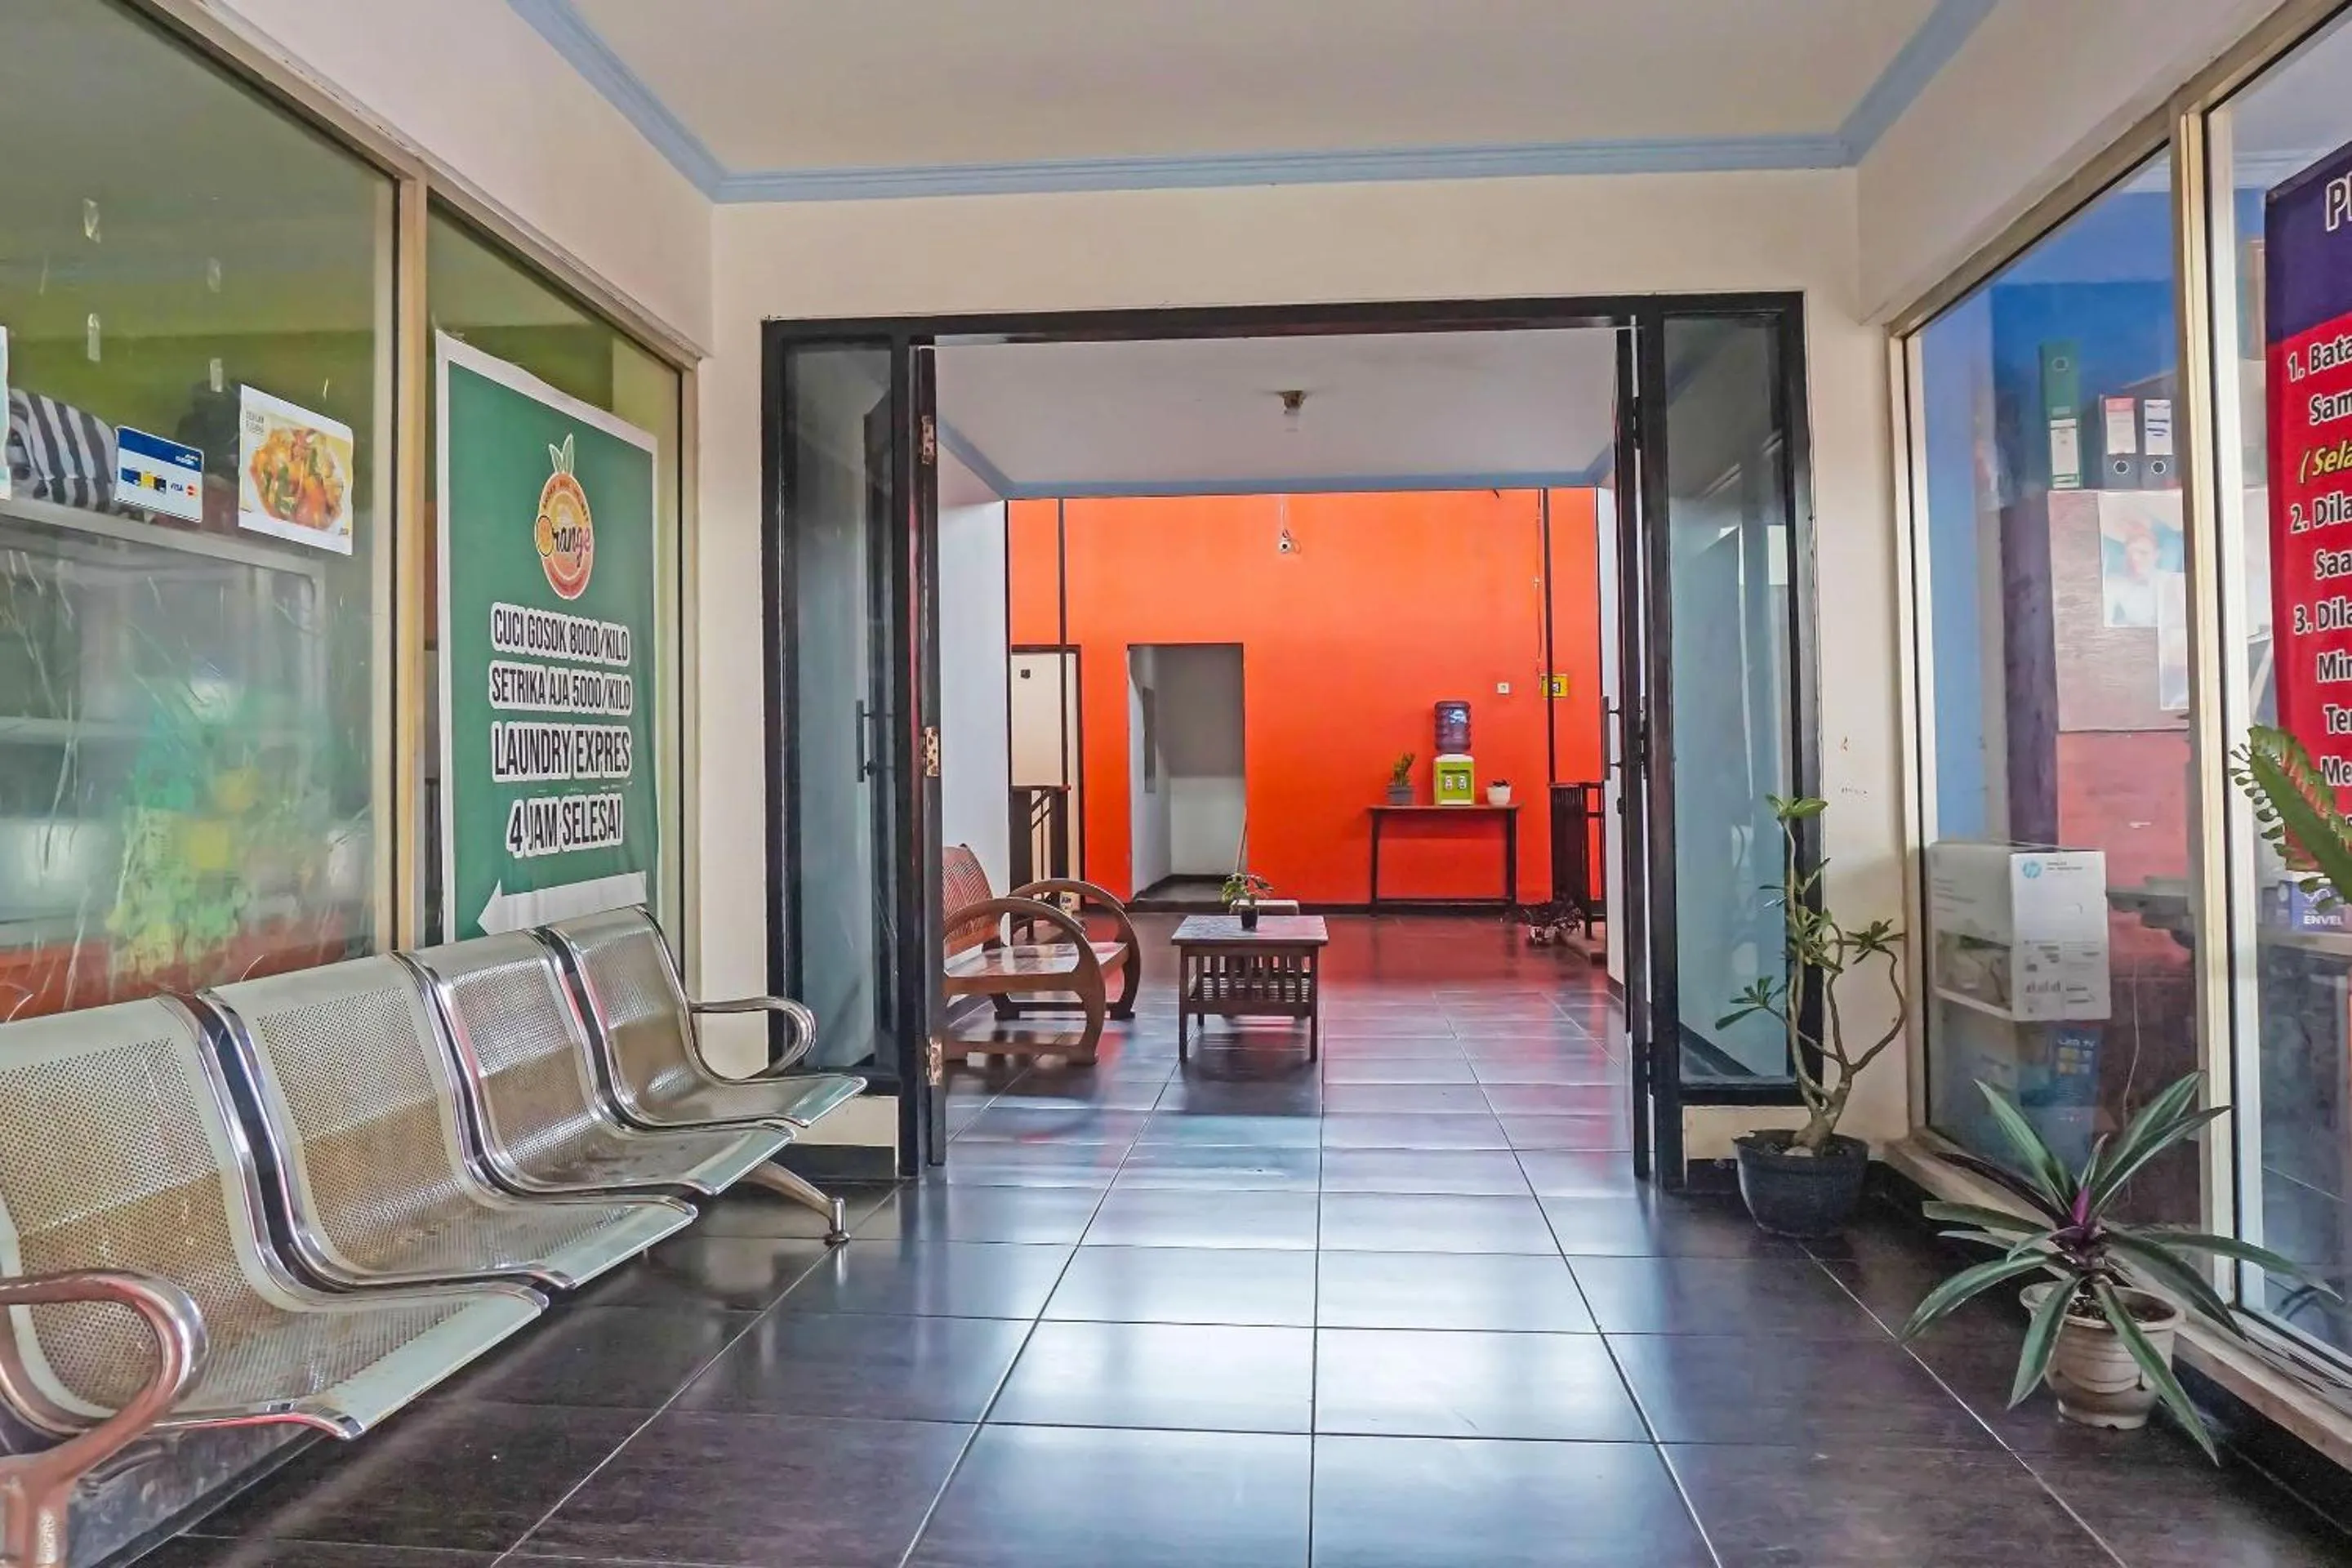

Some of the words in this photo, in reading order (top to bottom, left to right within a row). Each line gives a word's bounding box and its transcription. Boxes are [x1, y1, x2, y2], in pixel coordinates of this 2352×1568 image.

[2327, 170, 2352, 232] P
[2287, 351, 2305, 382] 1.
[2290, 502, 2310, 532] 2.
[494, 608, 524, 647] CUCI
[528, 616, 567, 653] GOSOK
[569, 621, 628, 661] 8000/KILO
[2293, 603, 2313, 635] 3.
[492, 667, 546, 705] SETRIKA
[548, 672, 570, 706] AJA
[572, 675, 631, 710] 5000/KILO
[494, 728, 572, 775] LAUNDRY
[576, 730, 630, 773] EXPRES
[509, 804, 523, 851] 4
[528, 803, 558, 850] JAM
[562, 798, 621, 845] SELESAI
